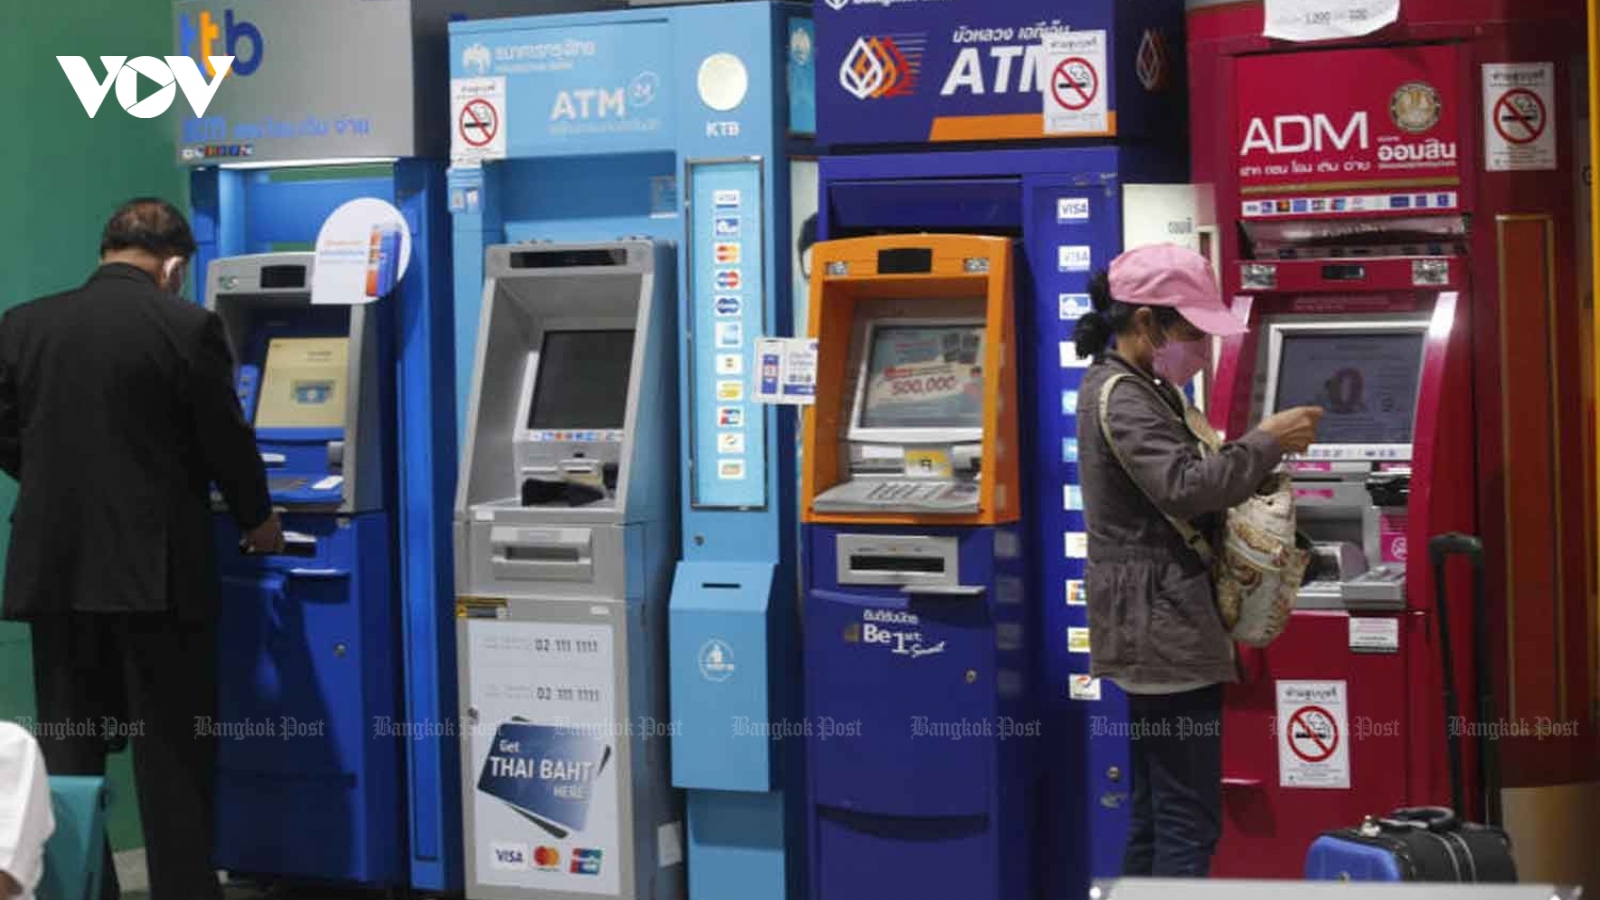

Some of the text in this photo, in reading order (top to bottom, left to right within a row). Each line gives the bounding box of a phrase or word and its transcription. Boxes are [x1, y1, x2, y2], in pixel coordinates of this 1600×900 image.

[952, 25, 1014, 43] บัวหลวง
[552, 89, 626, 120] ATM
[706, 121, 740, 137] KTB
[1239, 110, 1370, 156] ADM
[1377, 136, 1457, 162] ออมสิน
[1061, 203, 1087, 216] VISA
[891, 376, 957, 397] 500,000
[500, 740, 520, 752] Get
[490, 757, 592, 781] THAI BAHT
[496, 849, 523, 863] VISA
